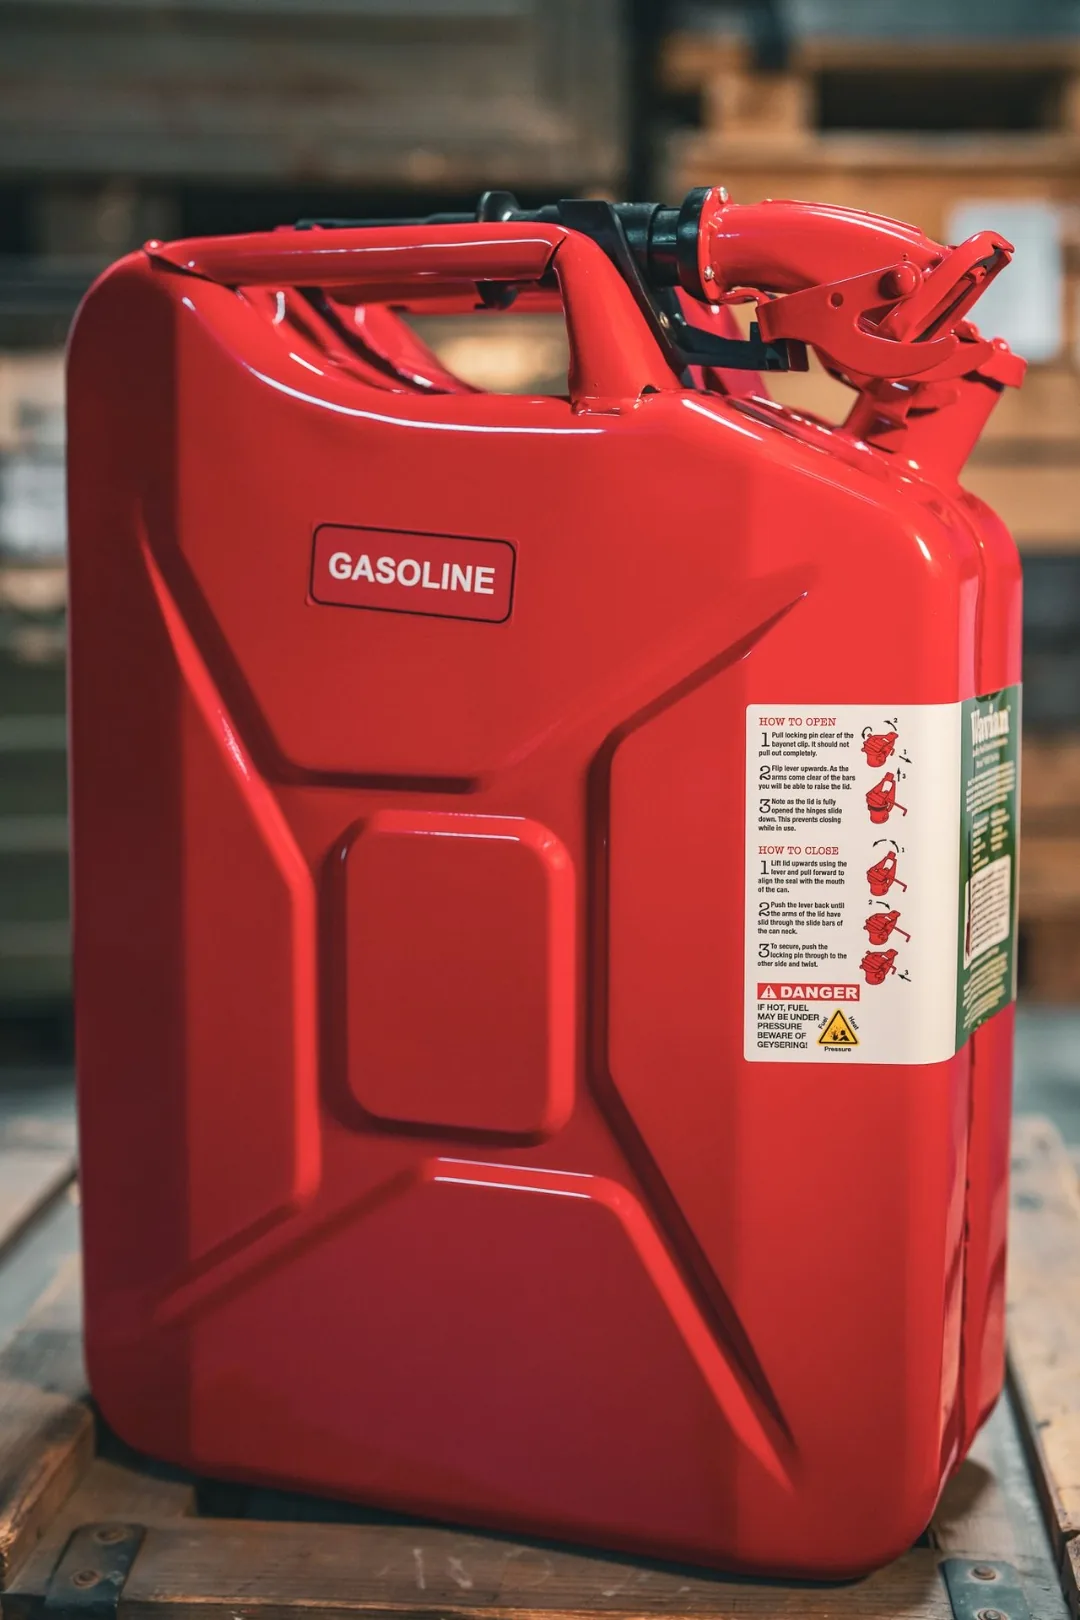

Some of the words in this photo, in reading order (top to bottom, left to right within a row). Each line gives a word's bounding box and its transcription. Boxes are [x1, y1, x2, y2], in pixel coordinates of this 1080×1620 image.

[329, 552, 495, 594] GASOLINE
[759, 718, 785, 726] HOW
[762, 733, 770, 747] 1
[760, 766, 771, 780] 2
[760, 799, 770, 813] 3
[759, 846, 784, 854] HOW
[805, 847, 838, 855] CLOSE
[761, 861, 769, 874] 1
[759, 902, 770, 916] 2
[759, 944, 769, 957] 3
[781, 986, 858, 999] DANGER
[818, 1017, 828, 1029] Fuel
[848, 1016, 859, 1030] Heat
